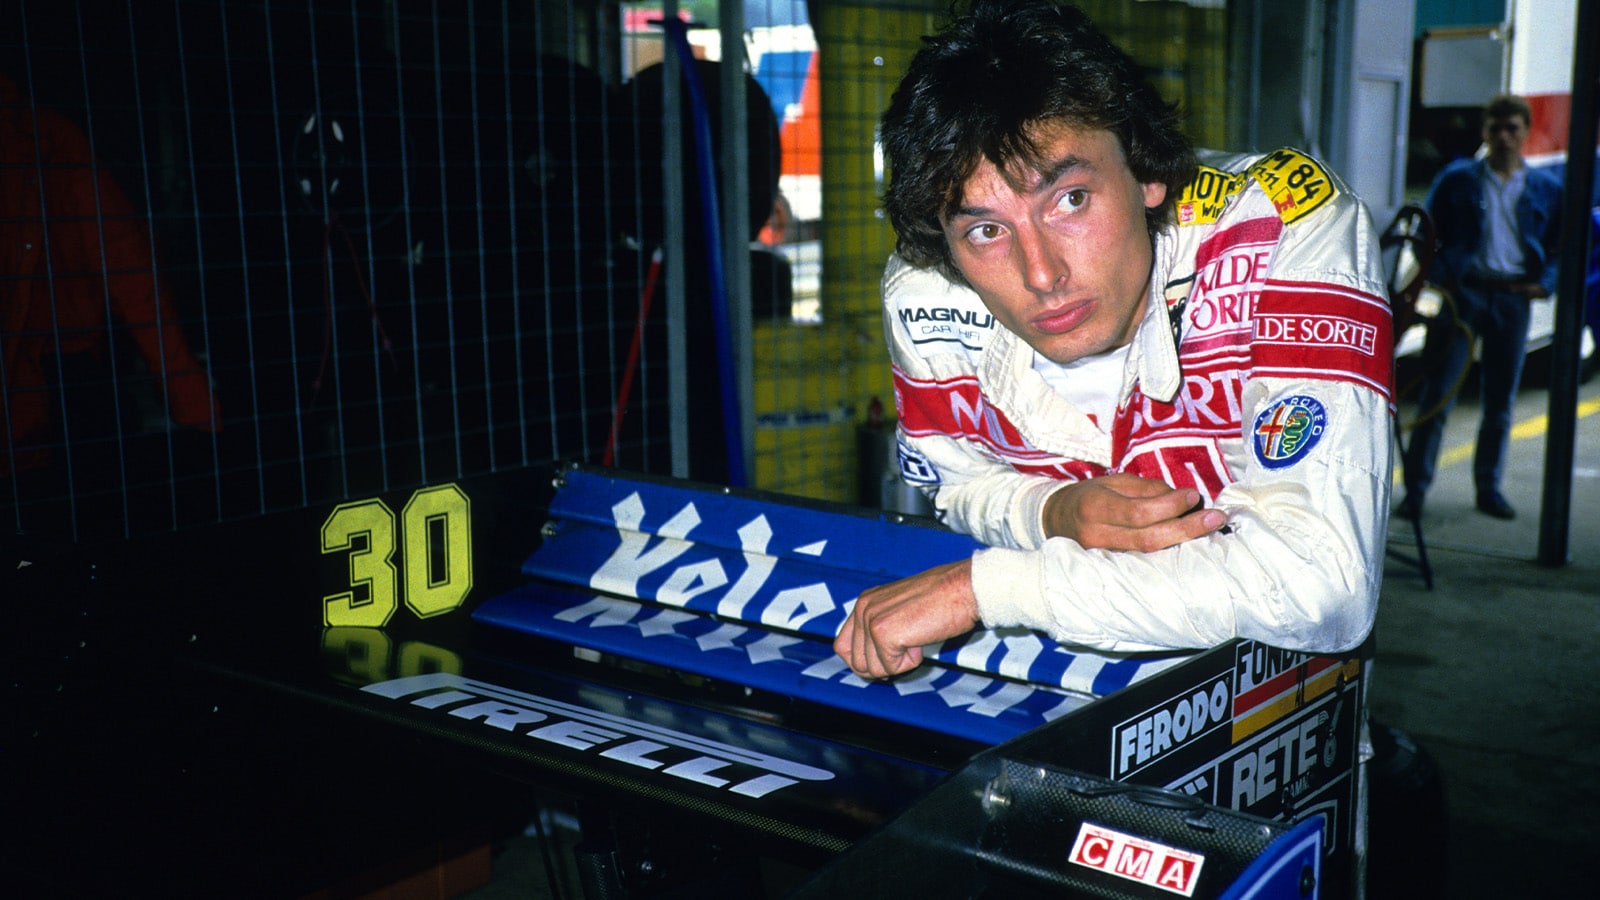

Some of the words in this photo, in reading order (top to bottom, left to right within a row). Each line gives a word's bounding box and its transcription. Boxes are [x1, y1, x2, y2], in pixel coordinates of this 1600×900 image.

[1286, 162, 1326, 206] 84
[897, 306, 996, 331] MAGNU
[920, 324, 952, 335] CAR
[1300, 318, 1374, 351] SORTE
[320, 482, 474, 628] 30
[358, 672, 836, 799] PIRELLI
[1119, 679, 1230, 775] FERODO
[1231, 713, 1320, 812] RETE
